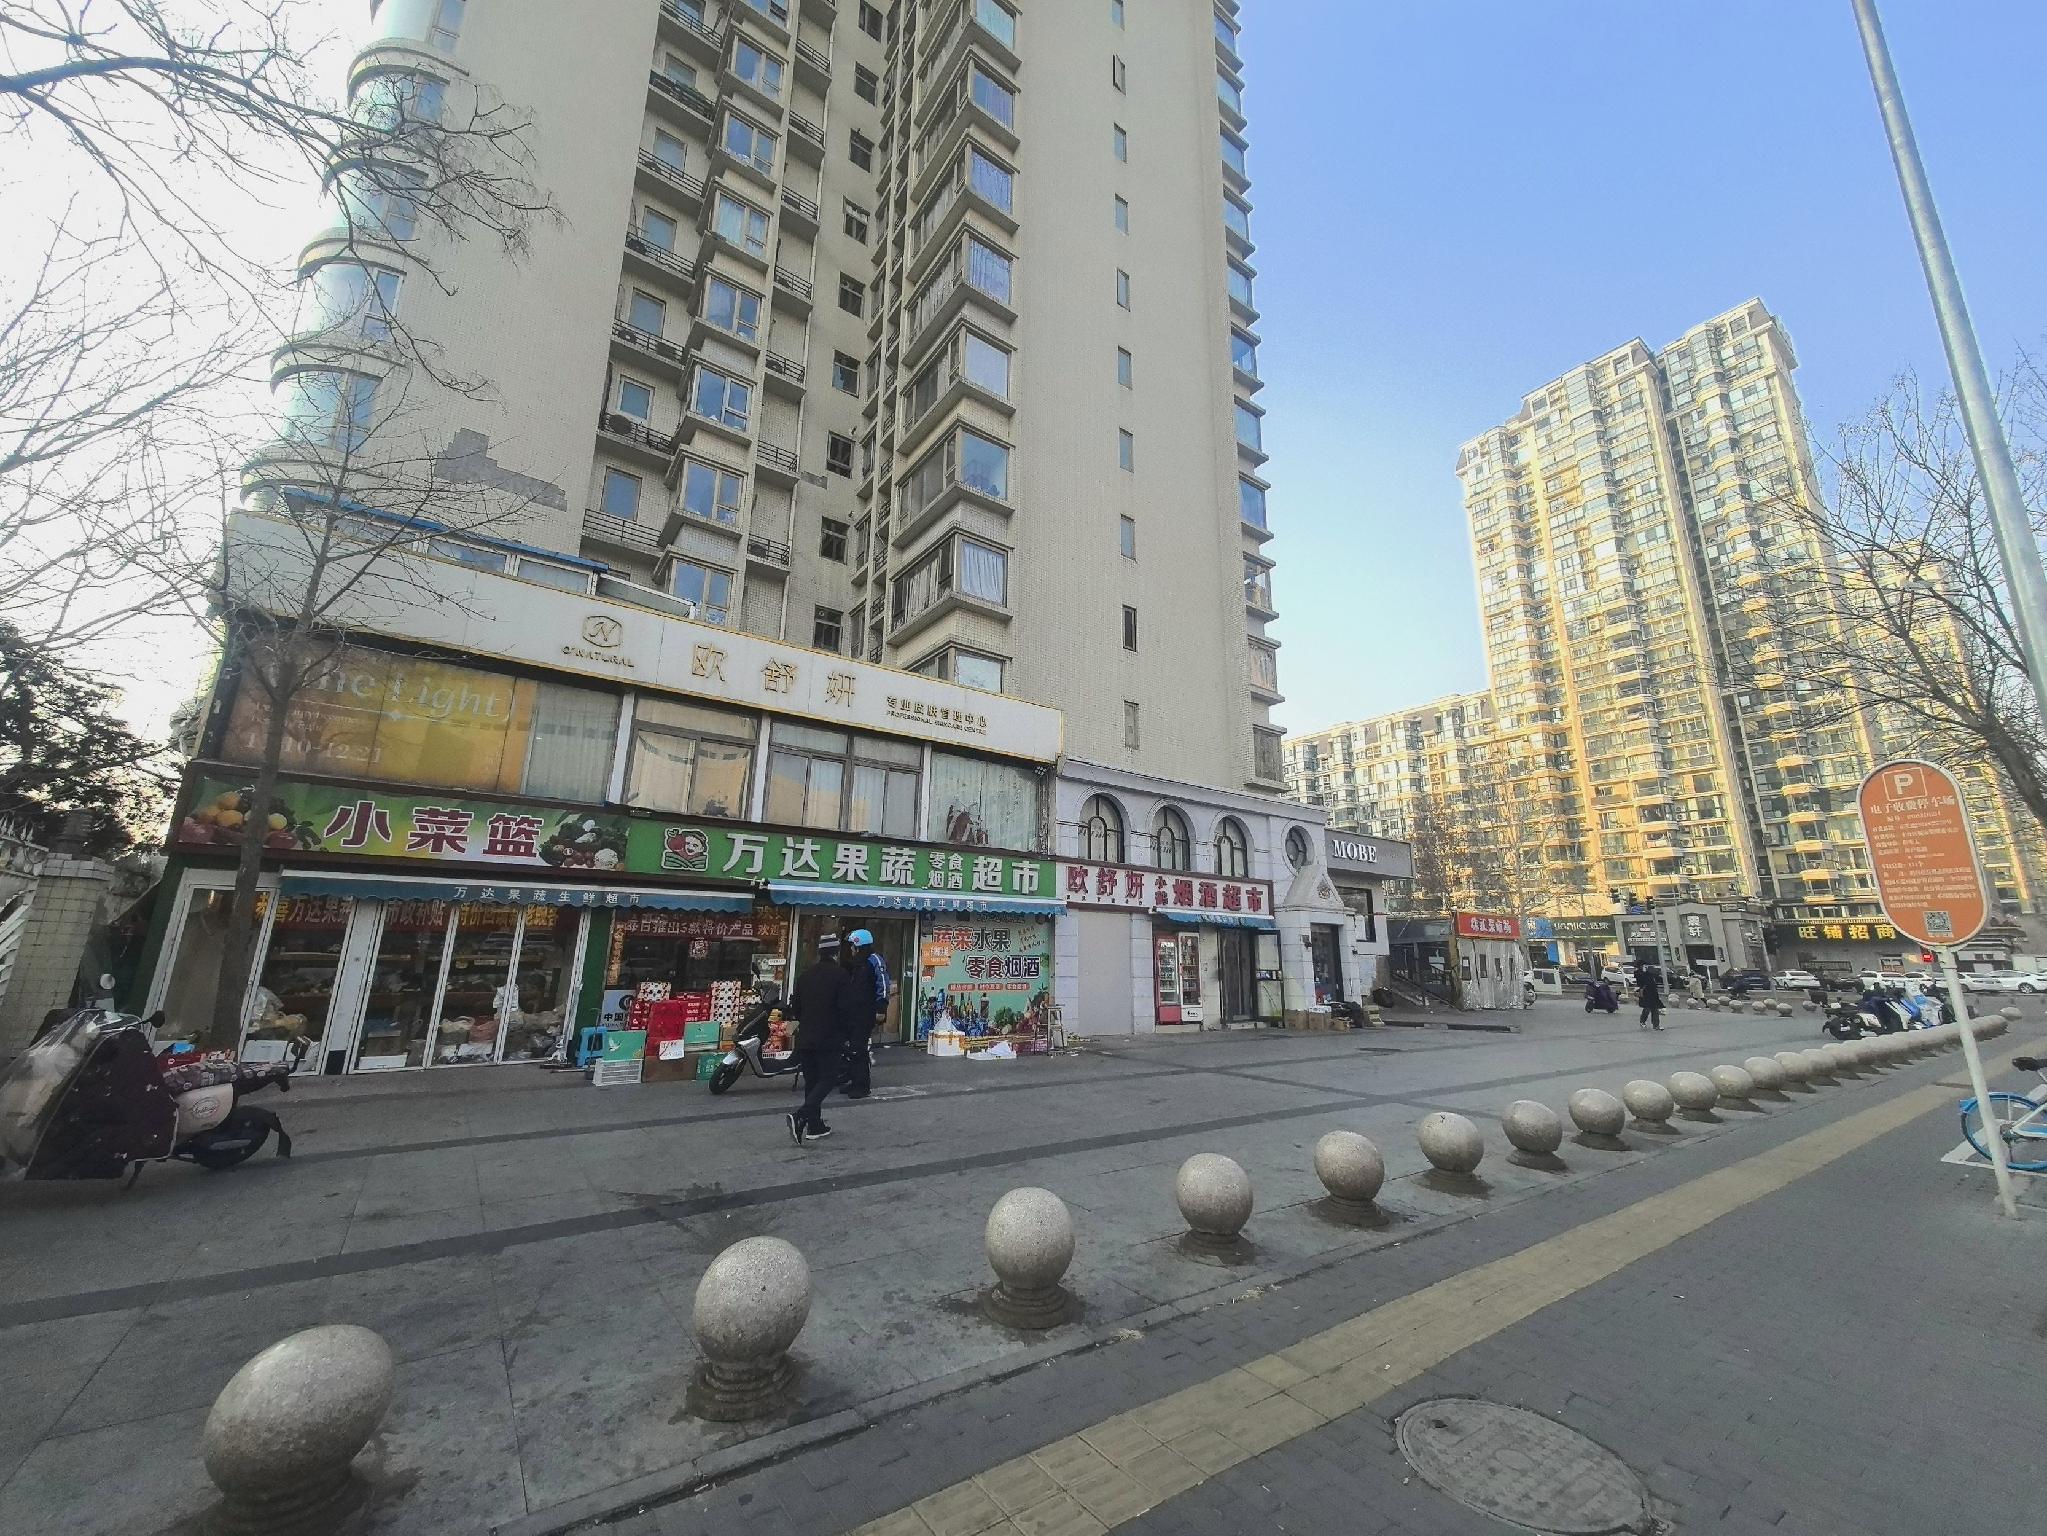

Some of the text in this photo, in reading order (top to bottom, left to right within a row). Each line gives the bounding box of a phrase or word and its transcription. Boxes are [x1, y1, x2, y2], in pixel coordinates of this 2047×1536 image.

[691, 643, 856, 708] 欧舒妍
[886, 695, 987, 727] 专业皮肤管理中心
[1893, 773, 1914, 796] P
[323, 800, 545, 858] 小菜篮
[722, 832, 1041, 896] 万达果蔬 零食 烟酒 超市
[1332, 839, 1377, 864] MOBE
[453, 885, 641, 904] 万达果蔬生鲜超市
[1066, 865, 1144, 900] 欧舒妍
[1172, 878, 1264, 912] 烟酒超市
[932, 925, 1012, 952] 蔬菜水果
[1797, 924, 1897, 940] 旺铺招商
[965, 954, 1041, 980] 零食烟酒
